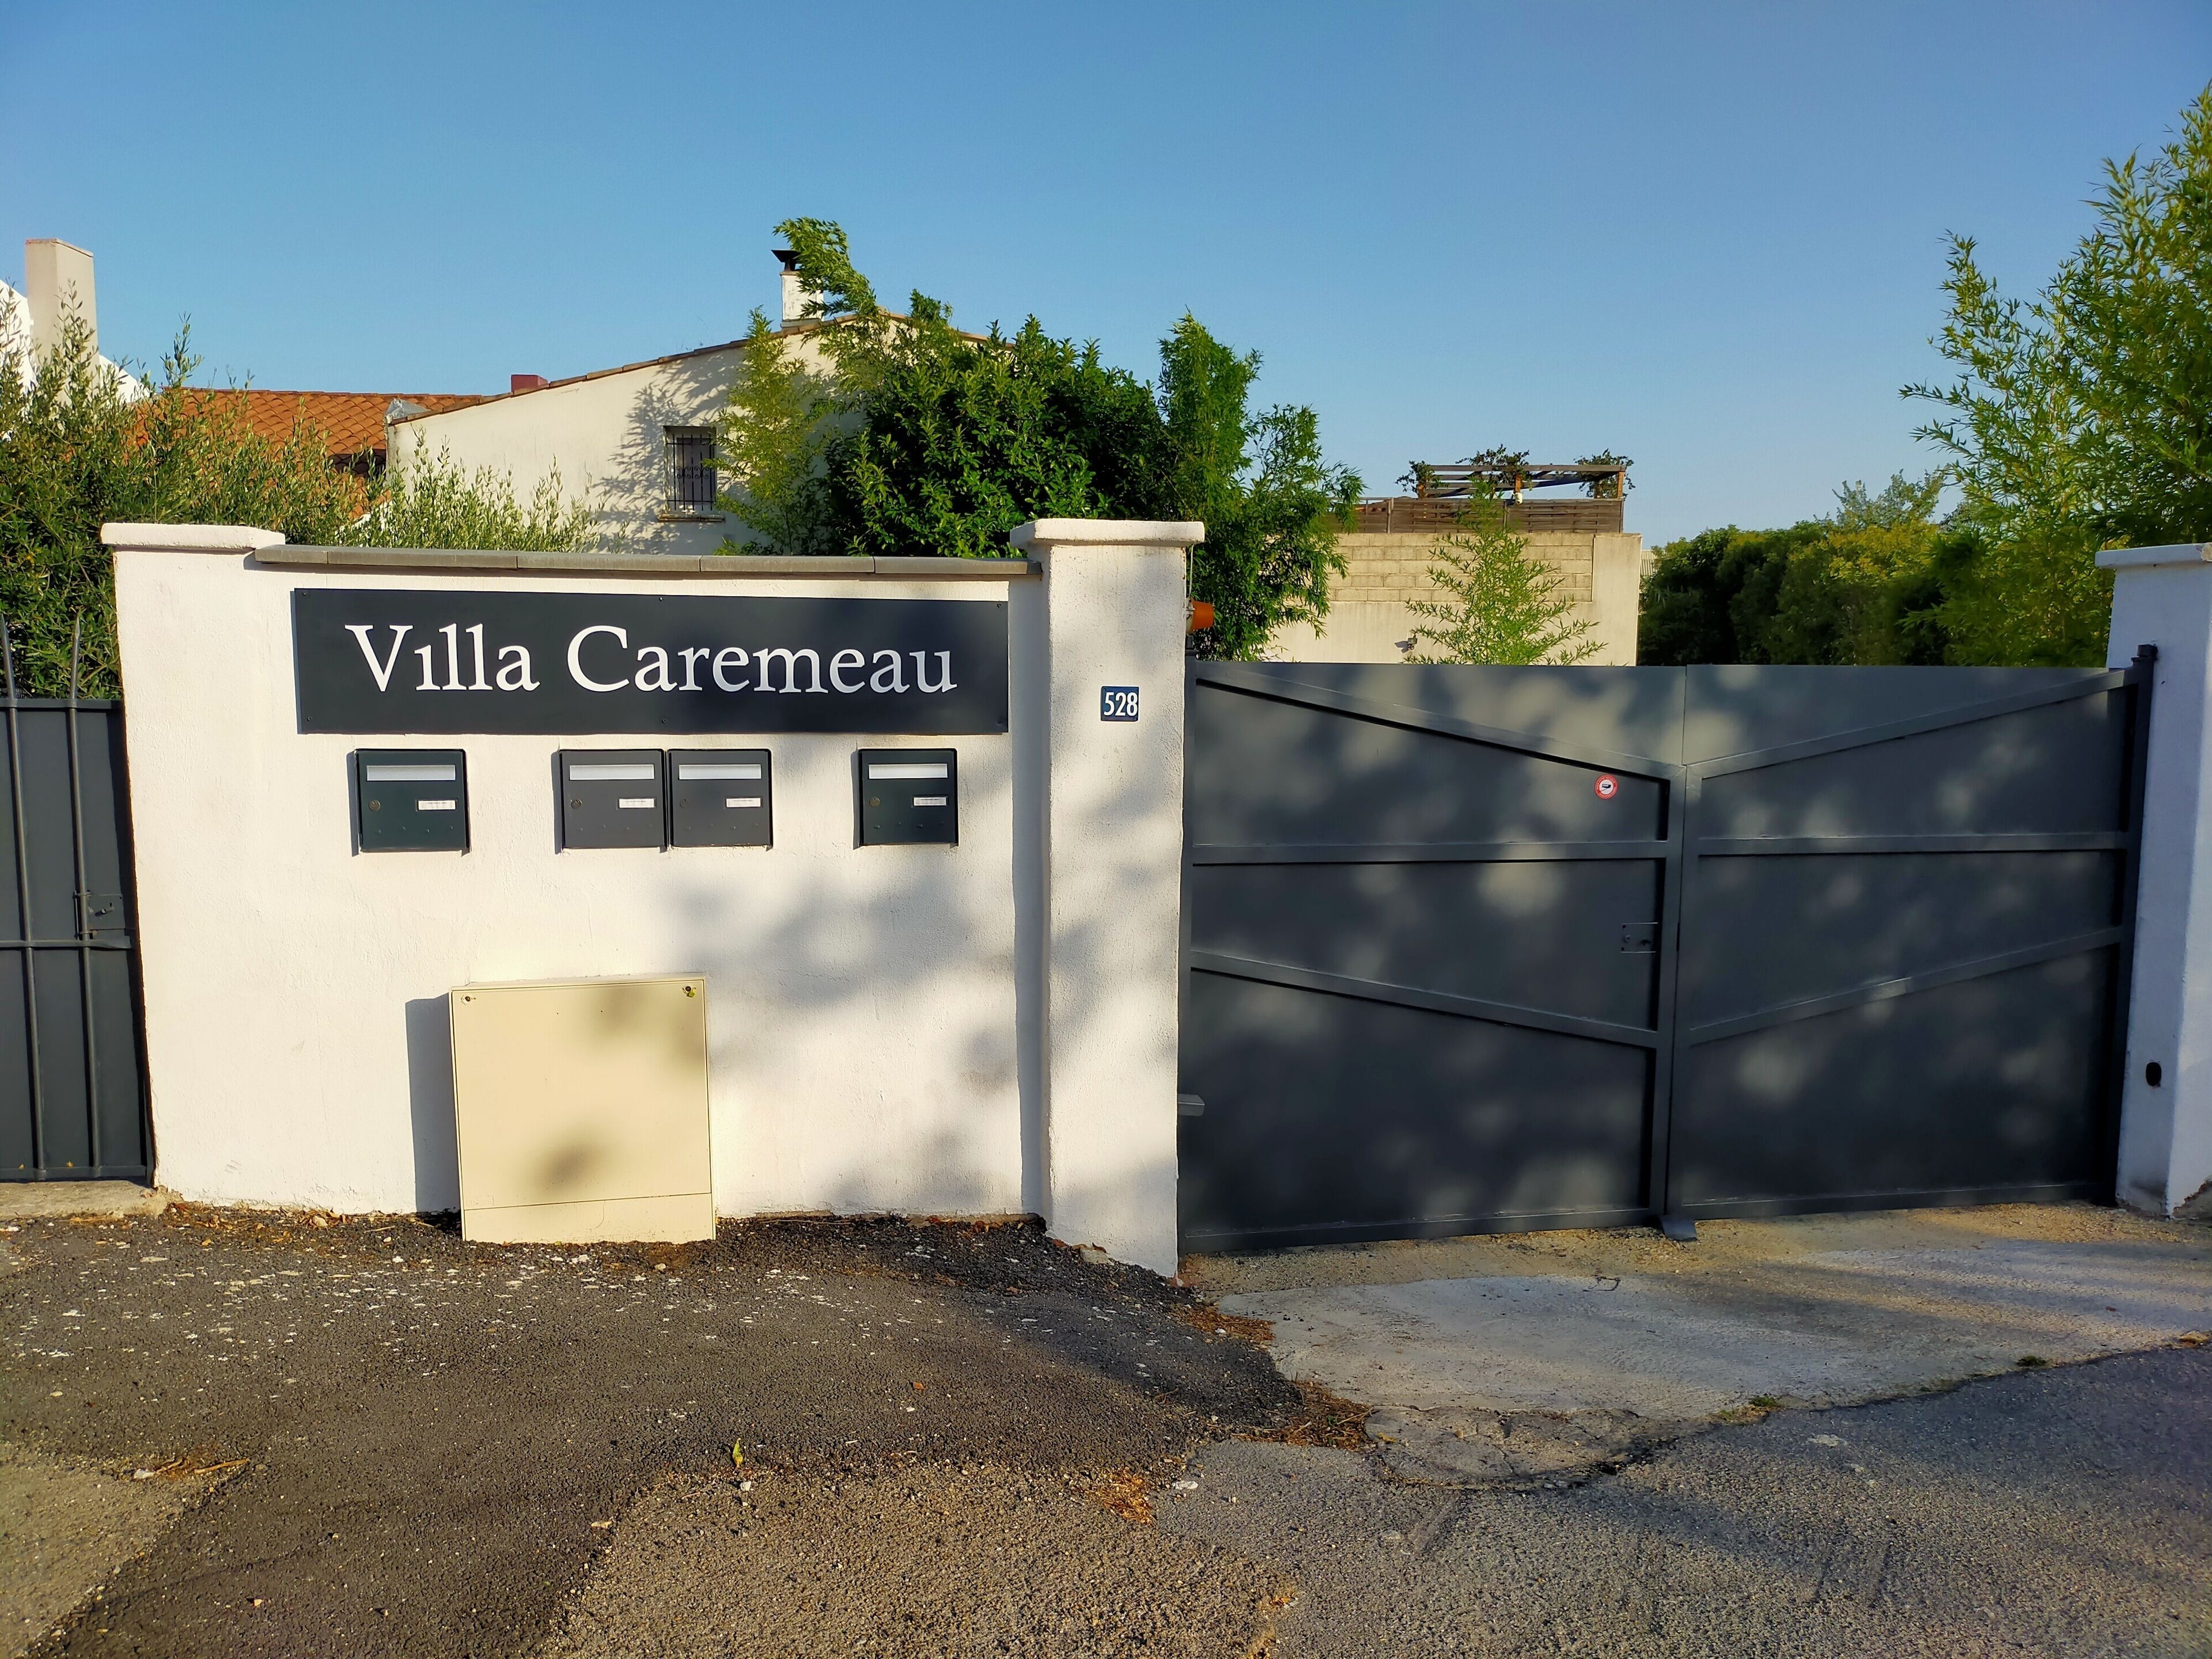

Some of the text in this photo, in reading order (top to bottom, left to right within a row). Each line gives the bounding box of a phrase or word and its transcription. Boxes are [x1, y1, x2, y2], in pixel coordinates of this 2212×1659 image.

[344, 623, 957, 694] Villa Caremeau
[1104, 692, 1138, 716] 528
